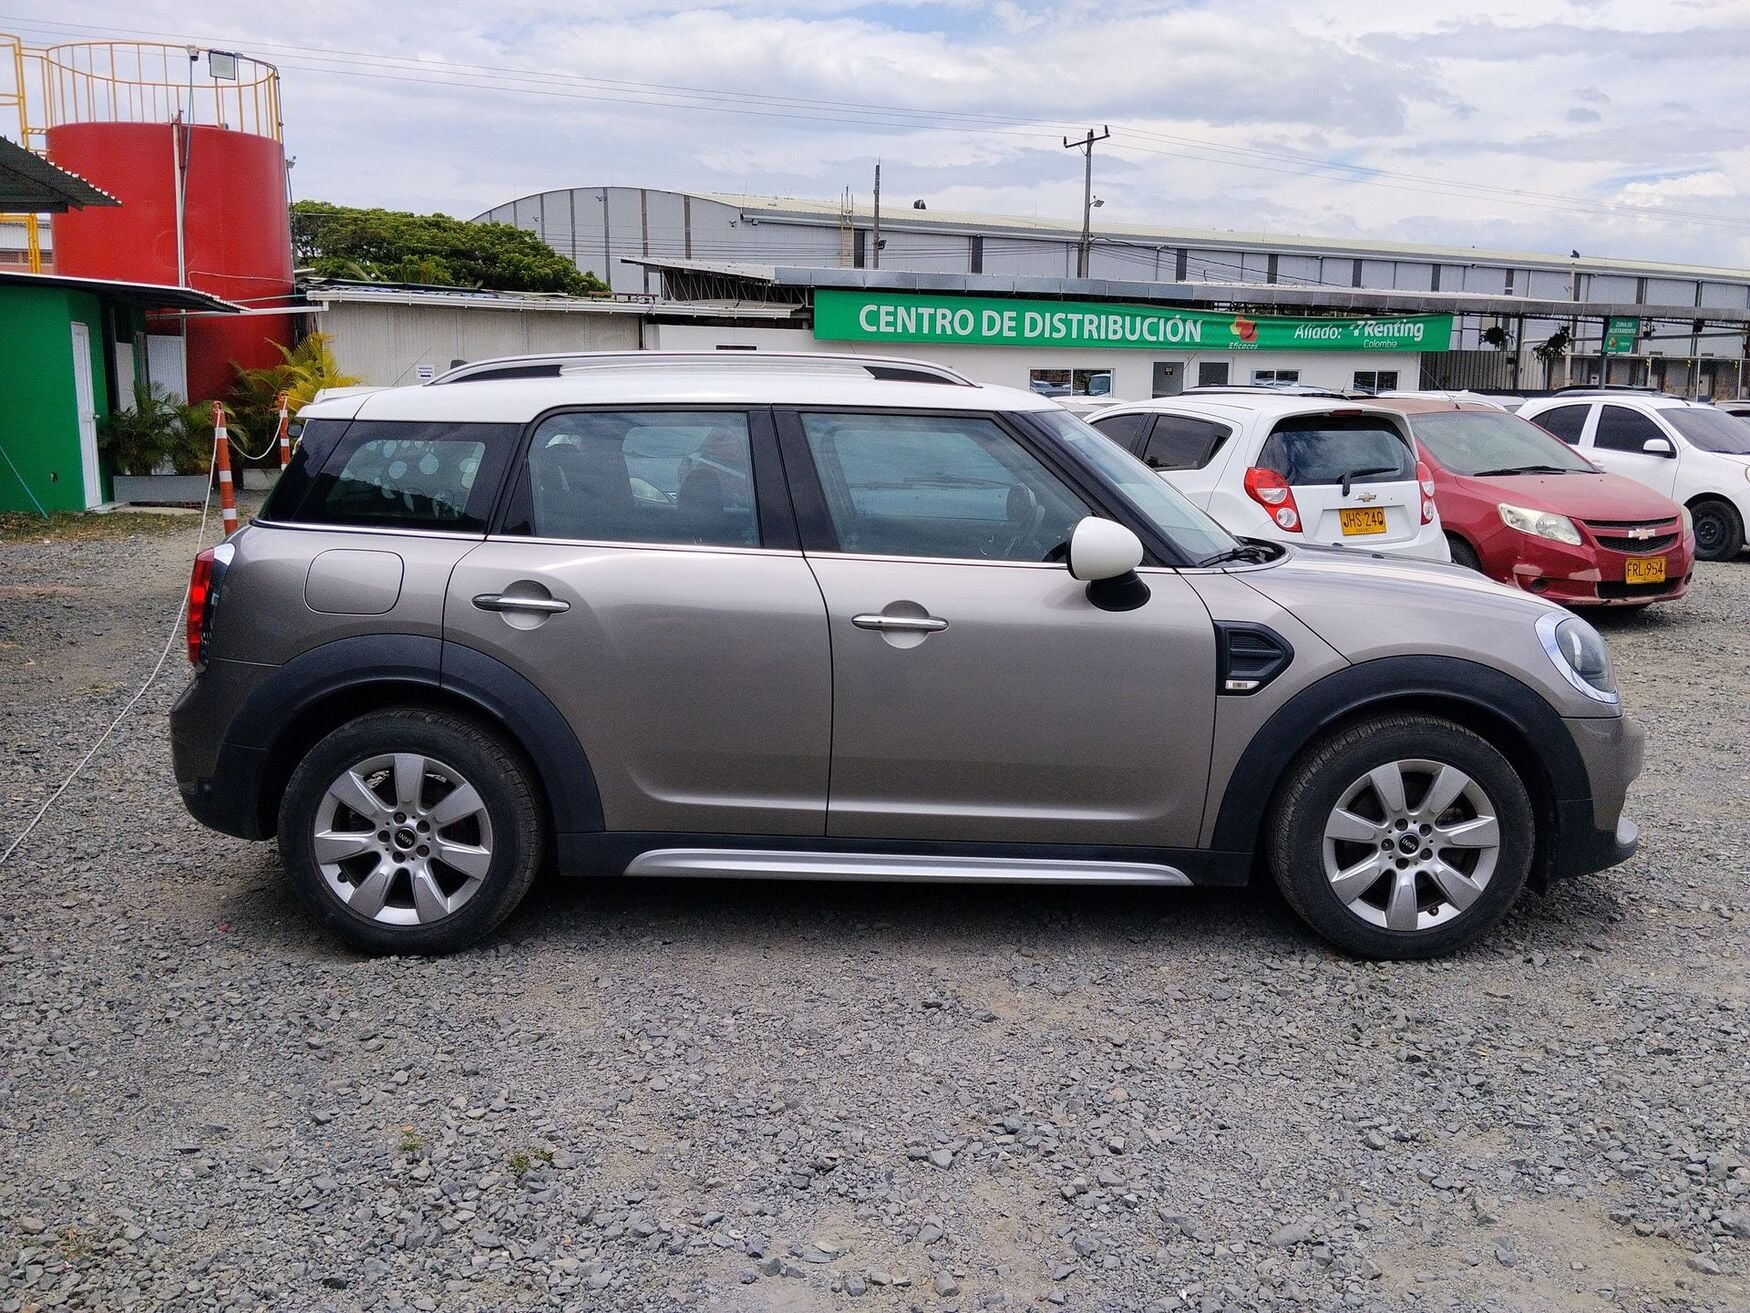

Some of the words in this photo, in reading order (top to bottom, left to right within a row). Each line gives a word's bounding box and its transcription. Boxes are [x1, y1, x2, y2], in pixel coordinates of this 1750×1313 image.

[859, 304, 975, 336] CENTRO
[981, 310, 1017, 338] DE
[1023, 311, 1203, 343] DISTRIBUCIÓN
[1293, 323, 1343, 339] Aliado:
[1364, 319, 1424, 342] Renting
[1363, 339, 1398, 348] Colombia
